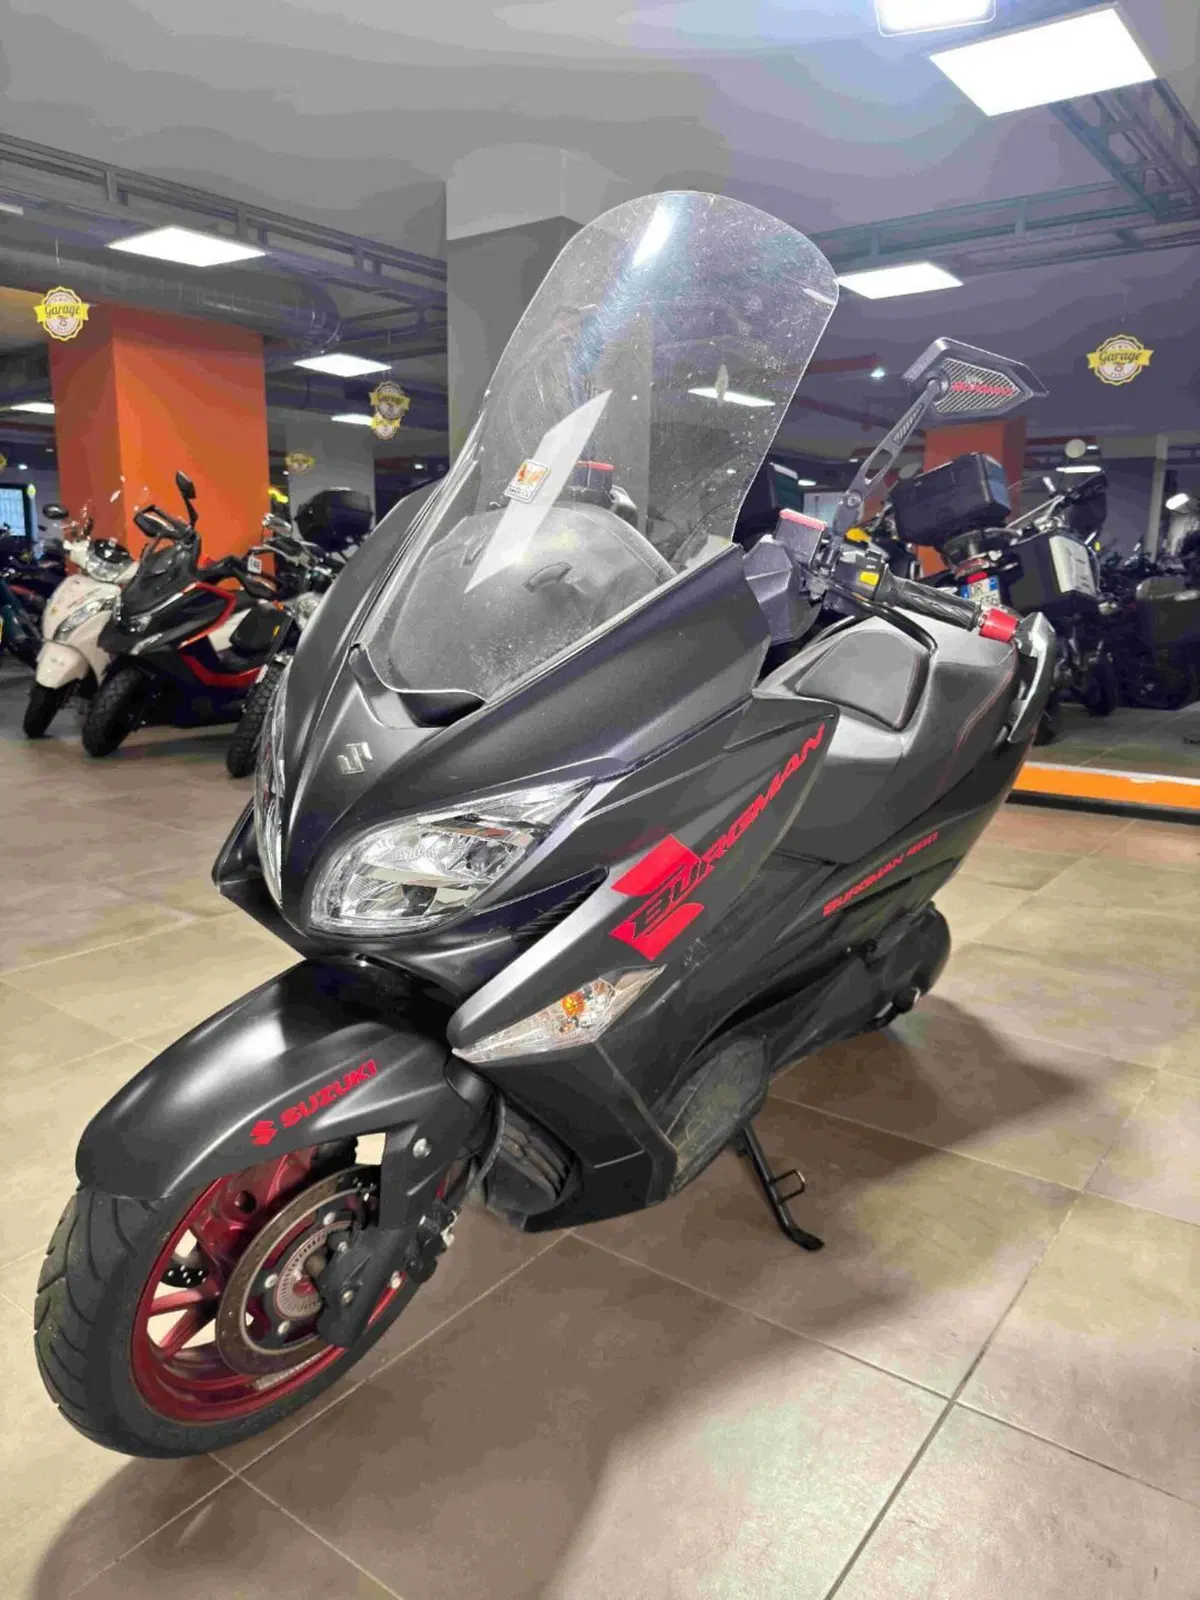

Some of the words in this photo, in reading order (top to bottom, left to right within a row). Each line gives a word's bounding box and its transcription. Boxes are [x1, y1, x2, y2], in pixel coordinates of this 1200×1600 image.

[45, 303, 81, 318] Garage
[1100, 351, 1140, 365] Garage
[279, 1058, 377, 1128] SUZUKI
